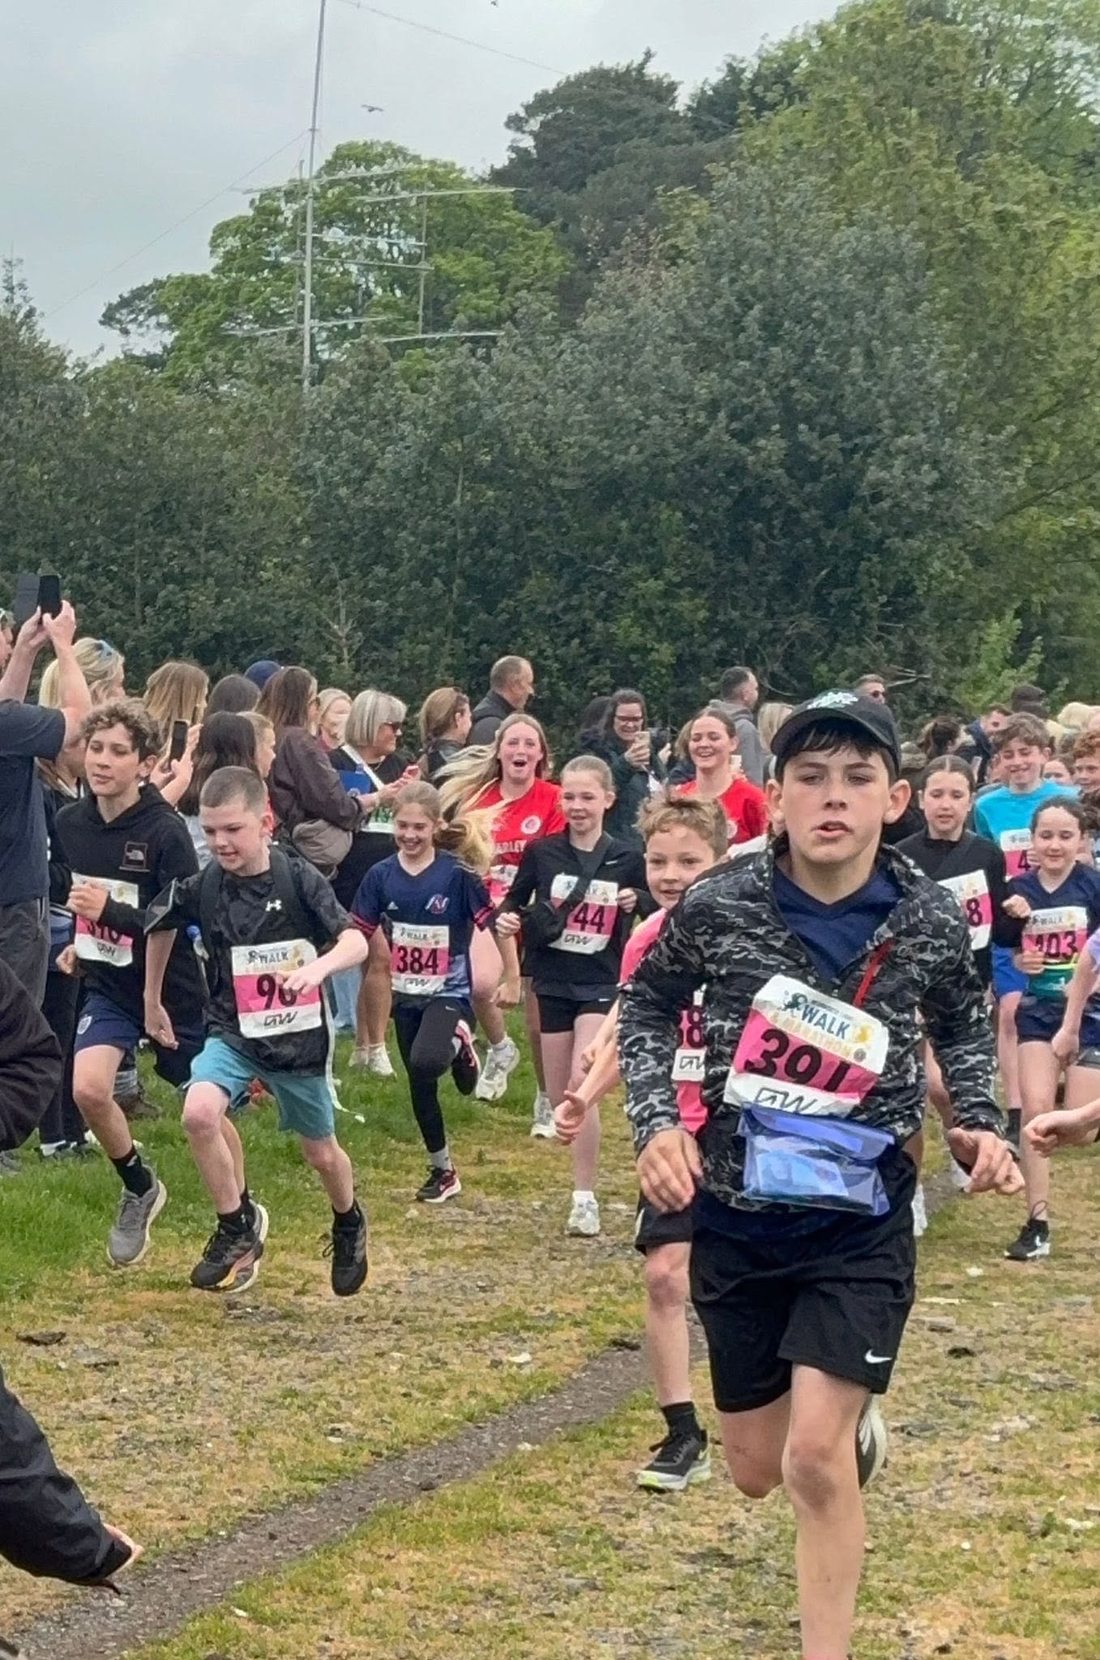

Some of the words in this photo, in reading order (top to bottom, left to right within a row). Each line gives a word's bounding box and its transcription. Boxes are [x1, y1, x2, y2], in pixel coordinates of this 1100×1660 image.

[259, 951, 289, 964] WALK
[397, 945, 439, 976] 384
[678, 1006, 705, 1050] 8
[801, 1004, 851, 1040] WALK
[744, 1028, 851, 1093] 391
